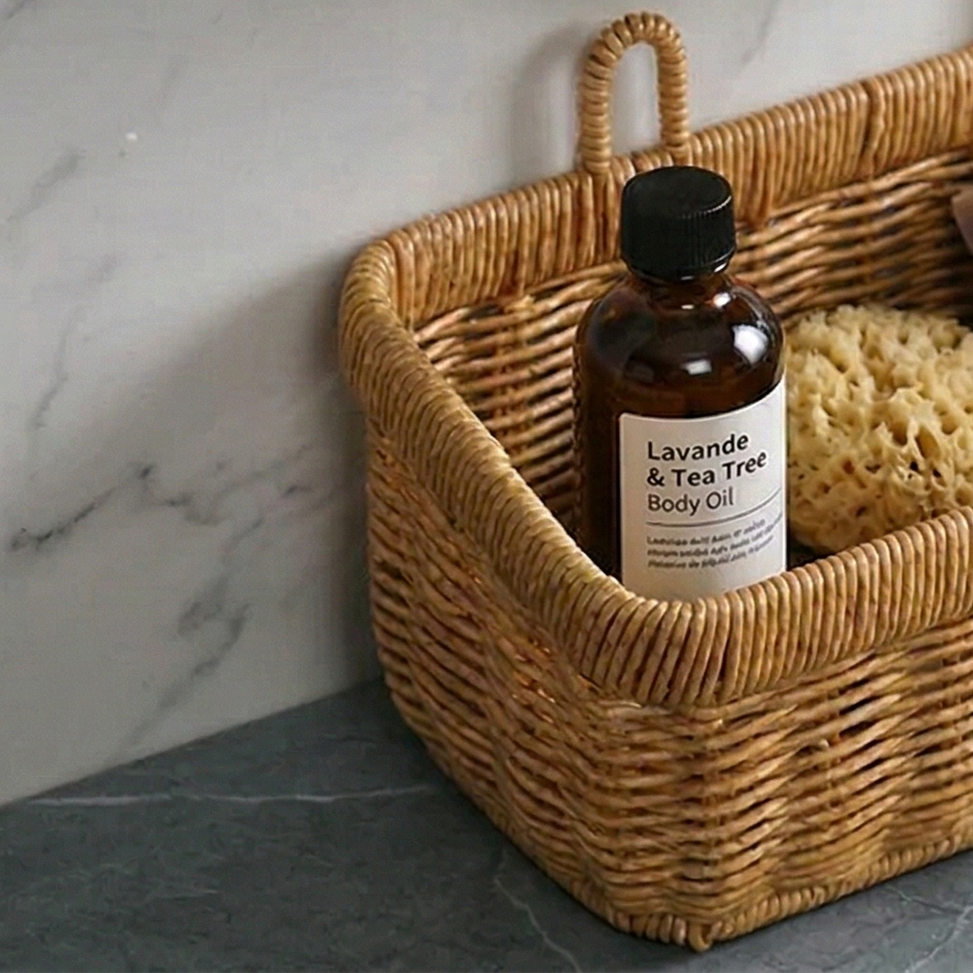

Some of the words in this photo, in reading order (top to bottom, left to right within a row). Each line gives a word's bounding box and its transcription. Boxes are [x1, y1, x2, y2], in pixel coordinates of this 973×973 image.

[647, 433, 749, 461] Lavande
[646, 467, 665, 487] &
[671, 468, 716, 487] Tea
[722, 451, 767, 480] Tree
[647, 493, 700, 516] Body
[705, 486, 734, 510] Oil
